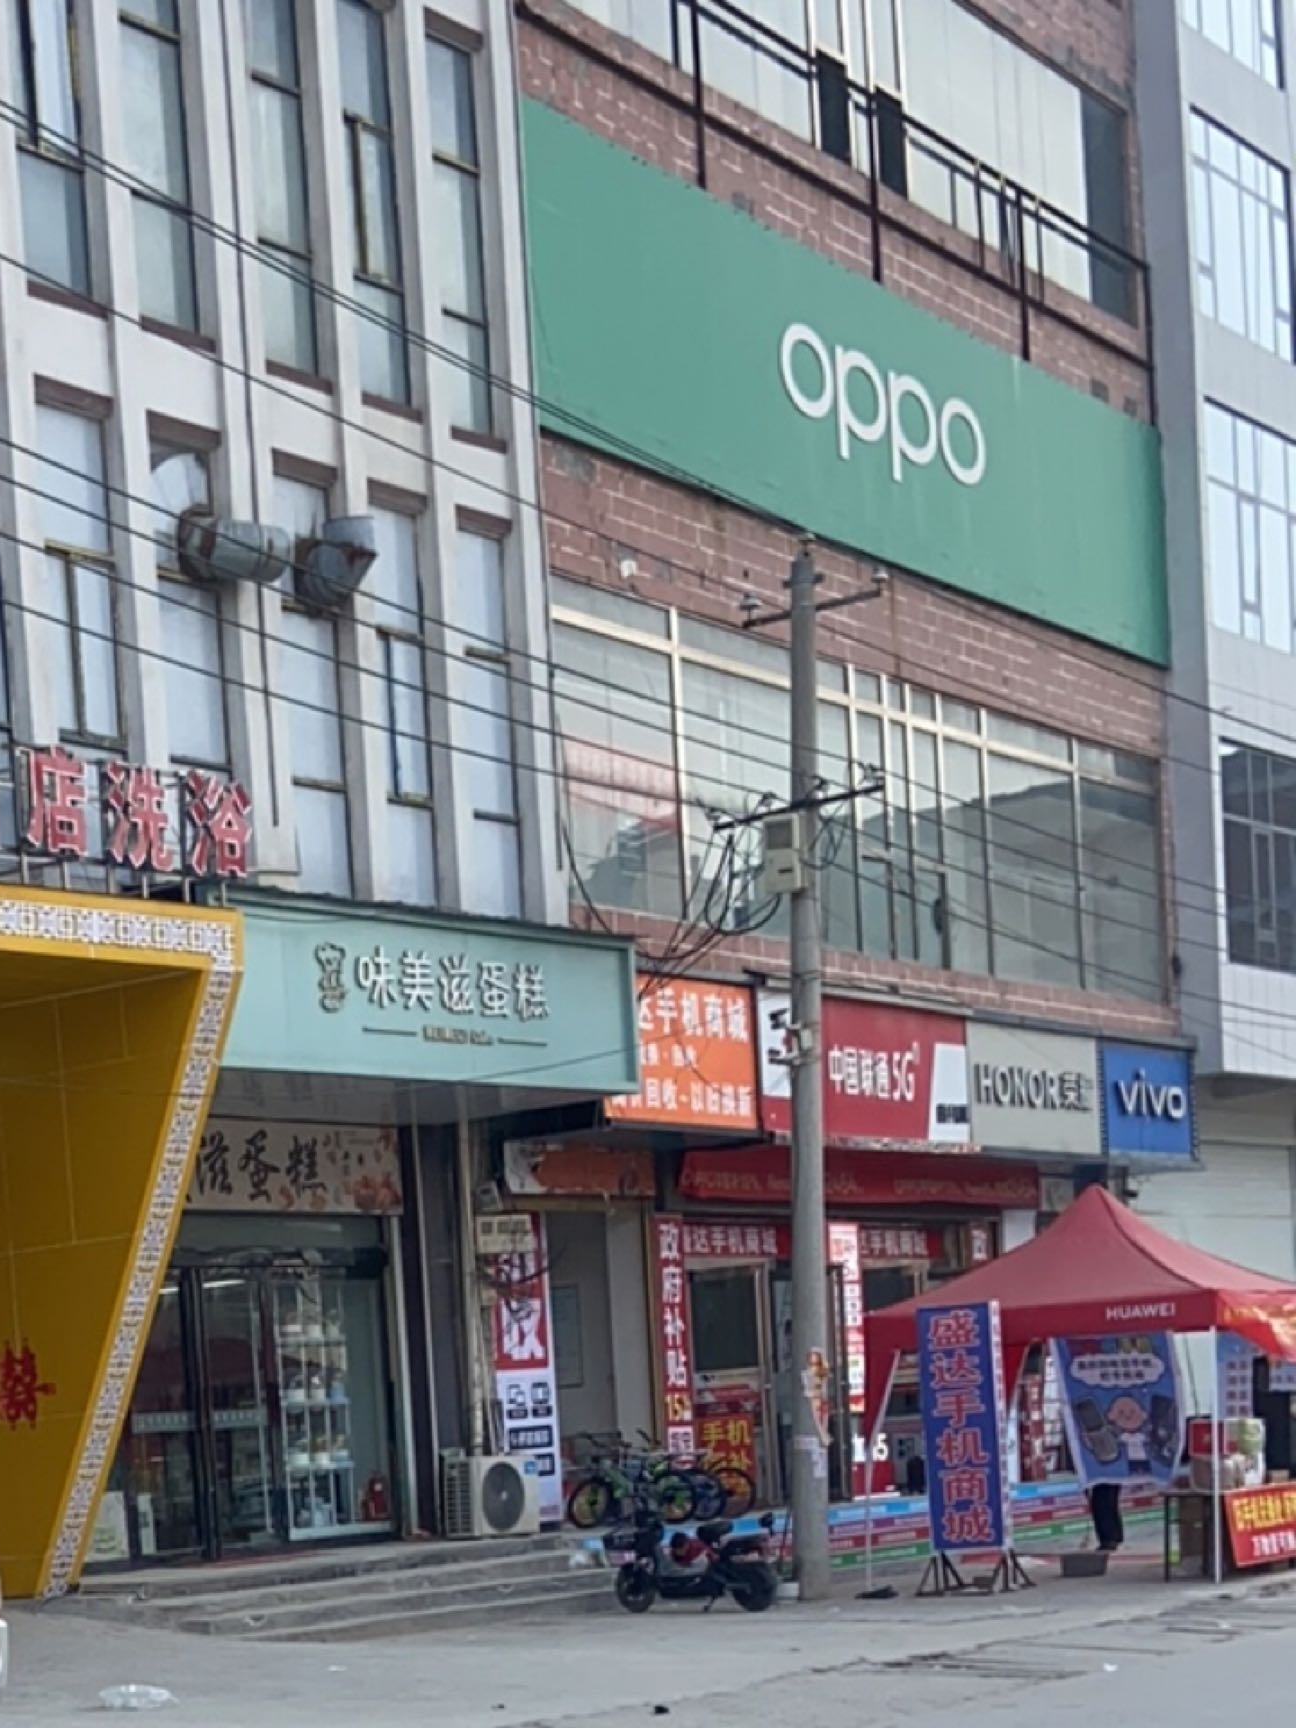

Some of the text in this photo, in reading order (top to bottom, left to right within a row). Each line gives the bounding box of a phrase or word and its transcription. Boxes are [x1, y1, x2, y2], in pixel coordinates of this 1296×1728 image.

[1113, 1067, 1188, 1120] vivo
[1106, 1302, 1177, 1321] HUAWEI
[927, 1309, 997, 1544] 盛达手机商城
